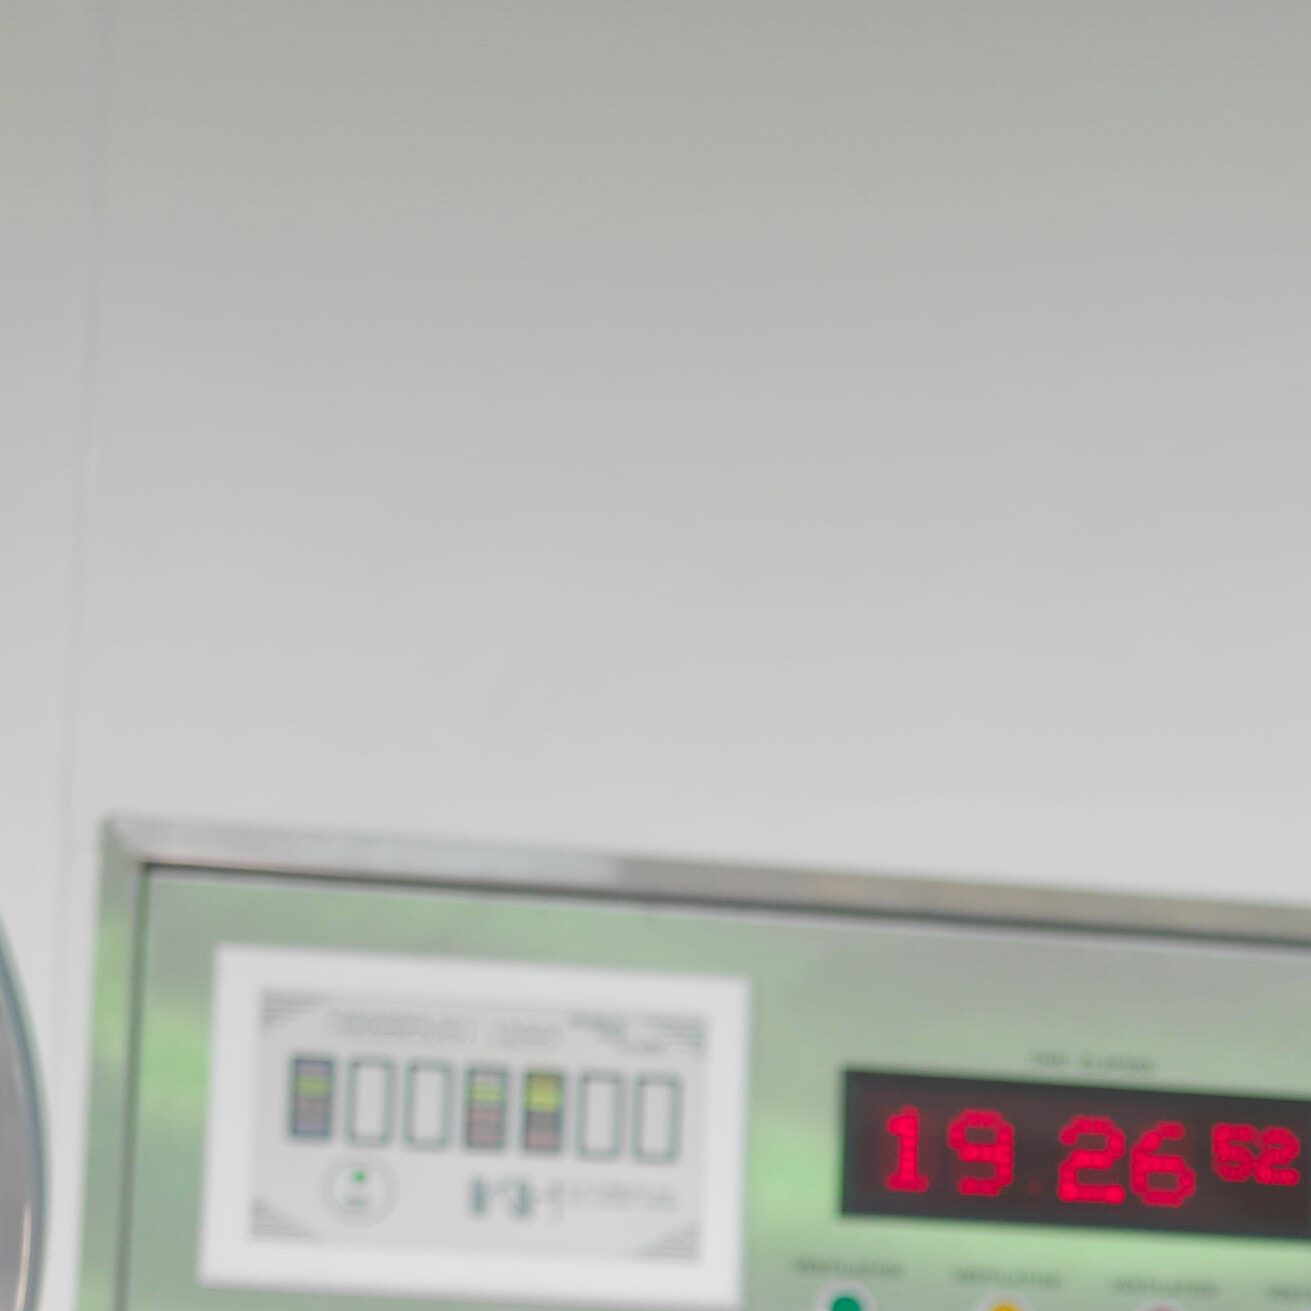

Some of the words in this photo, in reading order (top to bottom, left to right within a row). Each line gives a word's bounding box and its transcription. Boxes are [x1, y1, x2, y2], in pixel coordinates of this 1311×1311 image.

[884, 1106, 1014, 1196] 19
[1058, 1115, 1196, 1207] 26
[1210, 1122, 1300, 1186] 52
